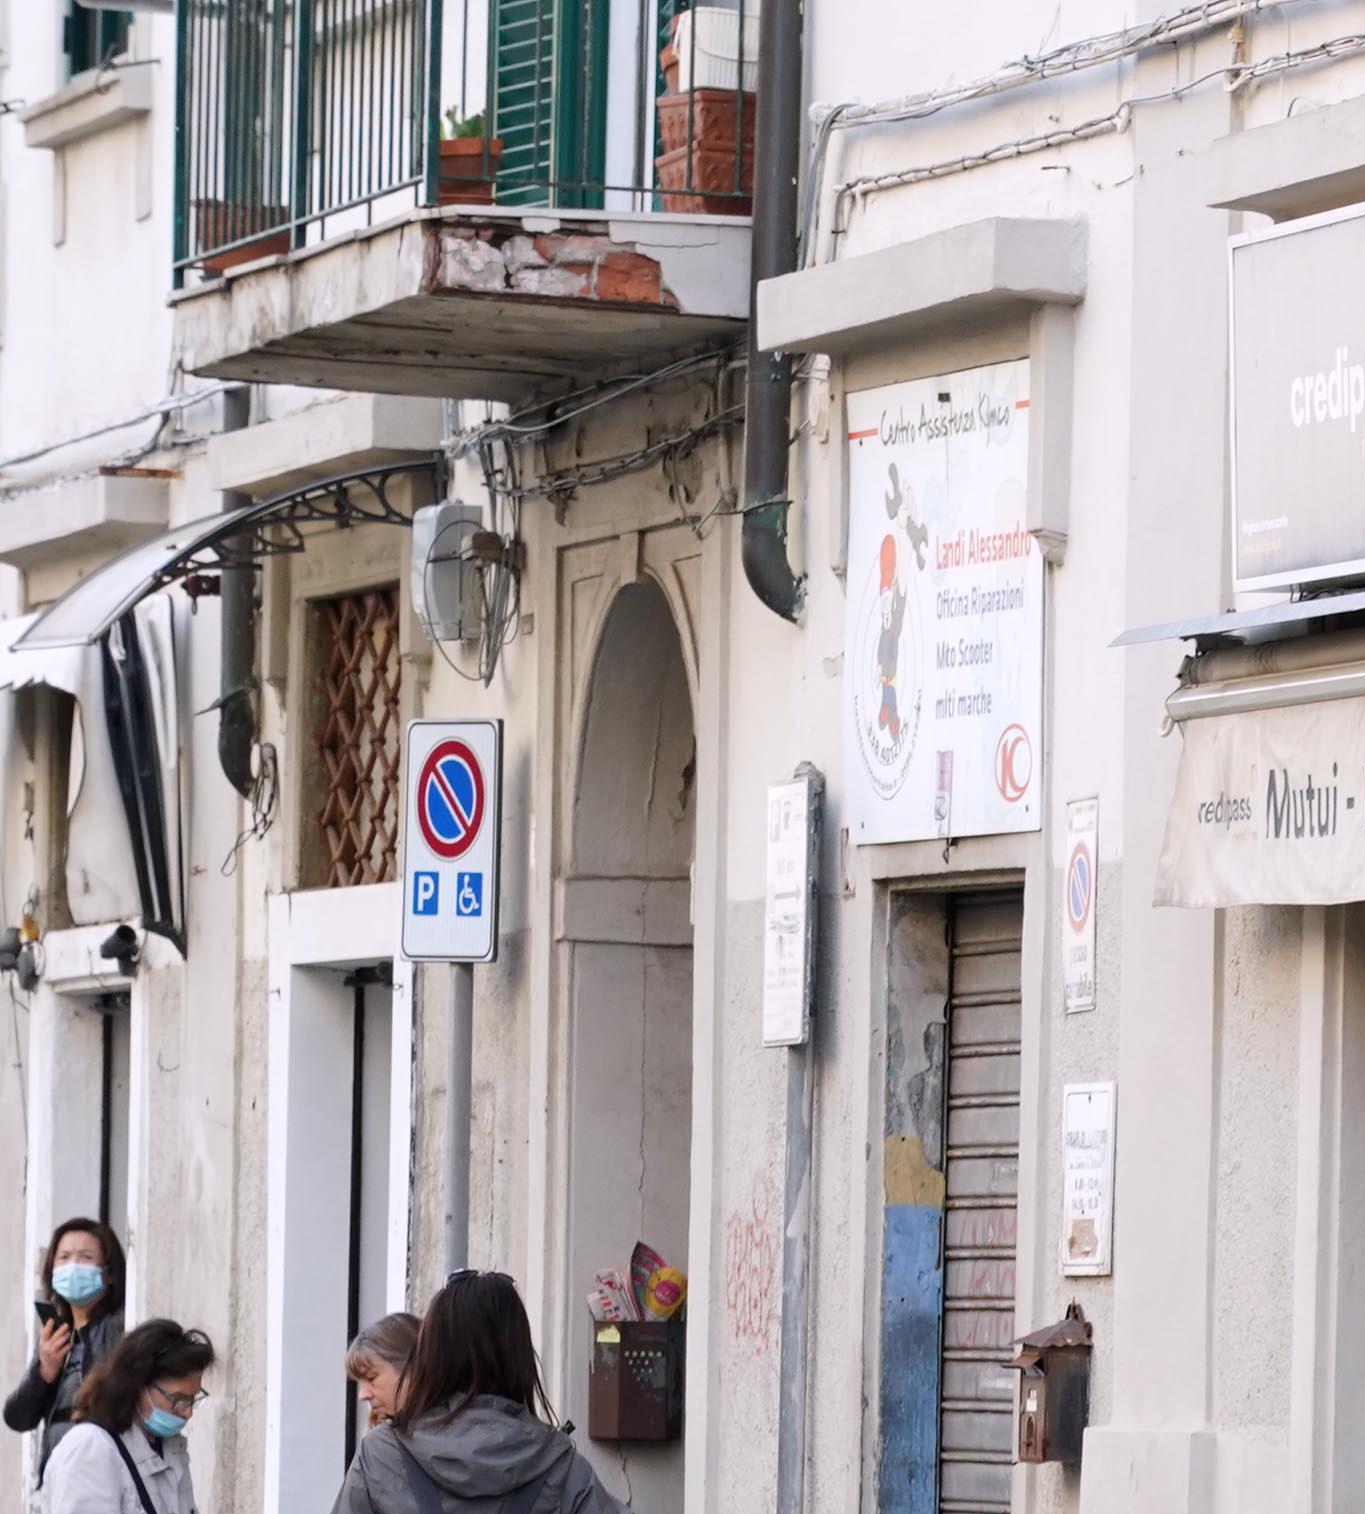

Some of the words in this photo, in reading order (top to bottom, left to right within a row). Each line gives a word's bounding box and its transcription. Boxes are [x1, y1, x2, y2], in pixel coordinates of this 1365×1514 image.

[936, 527, 965, 570] Landi
[968, 518, 1031, 566] Alessandro
[972, 578, 1024, 622] Riparazioni
[958, 636, 993, 668] Scooter
[957, 685, 992, 718] marche
[1265, 762, 1339, 839] Mutui
[417, 875, 435, 912] P
